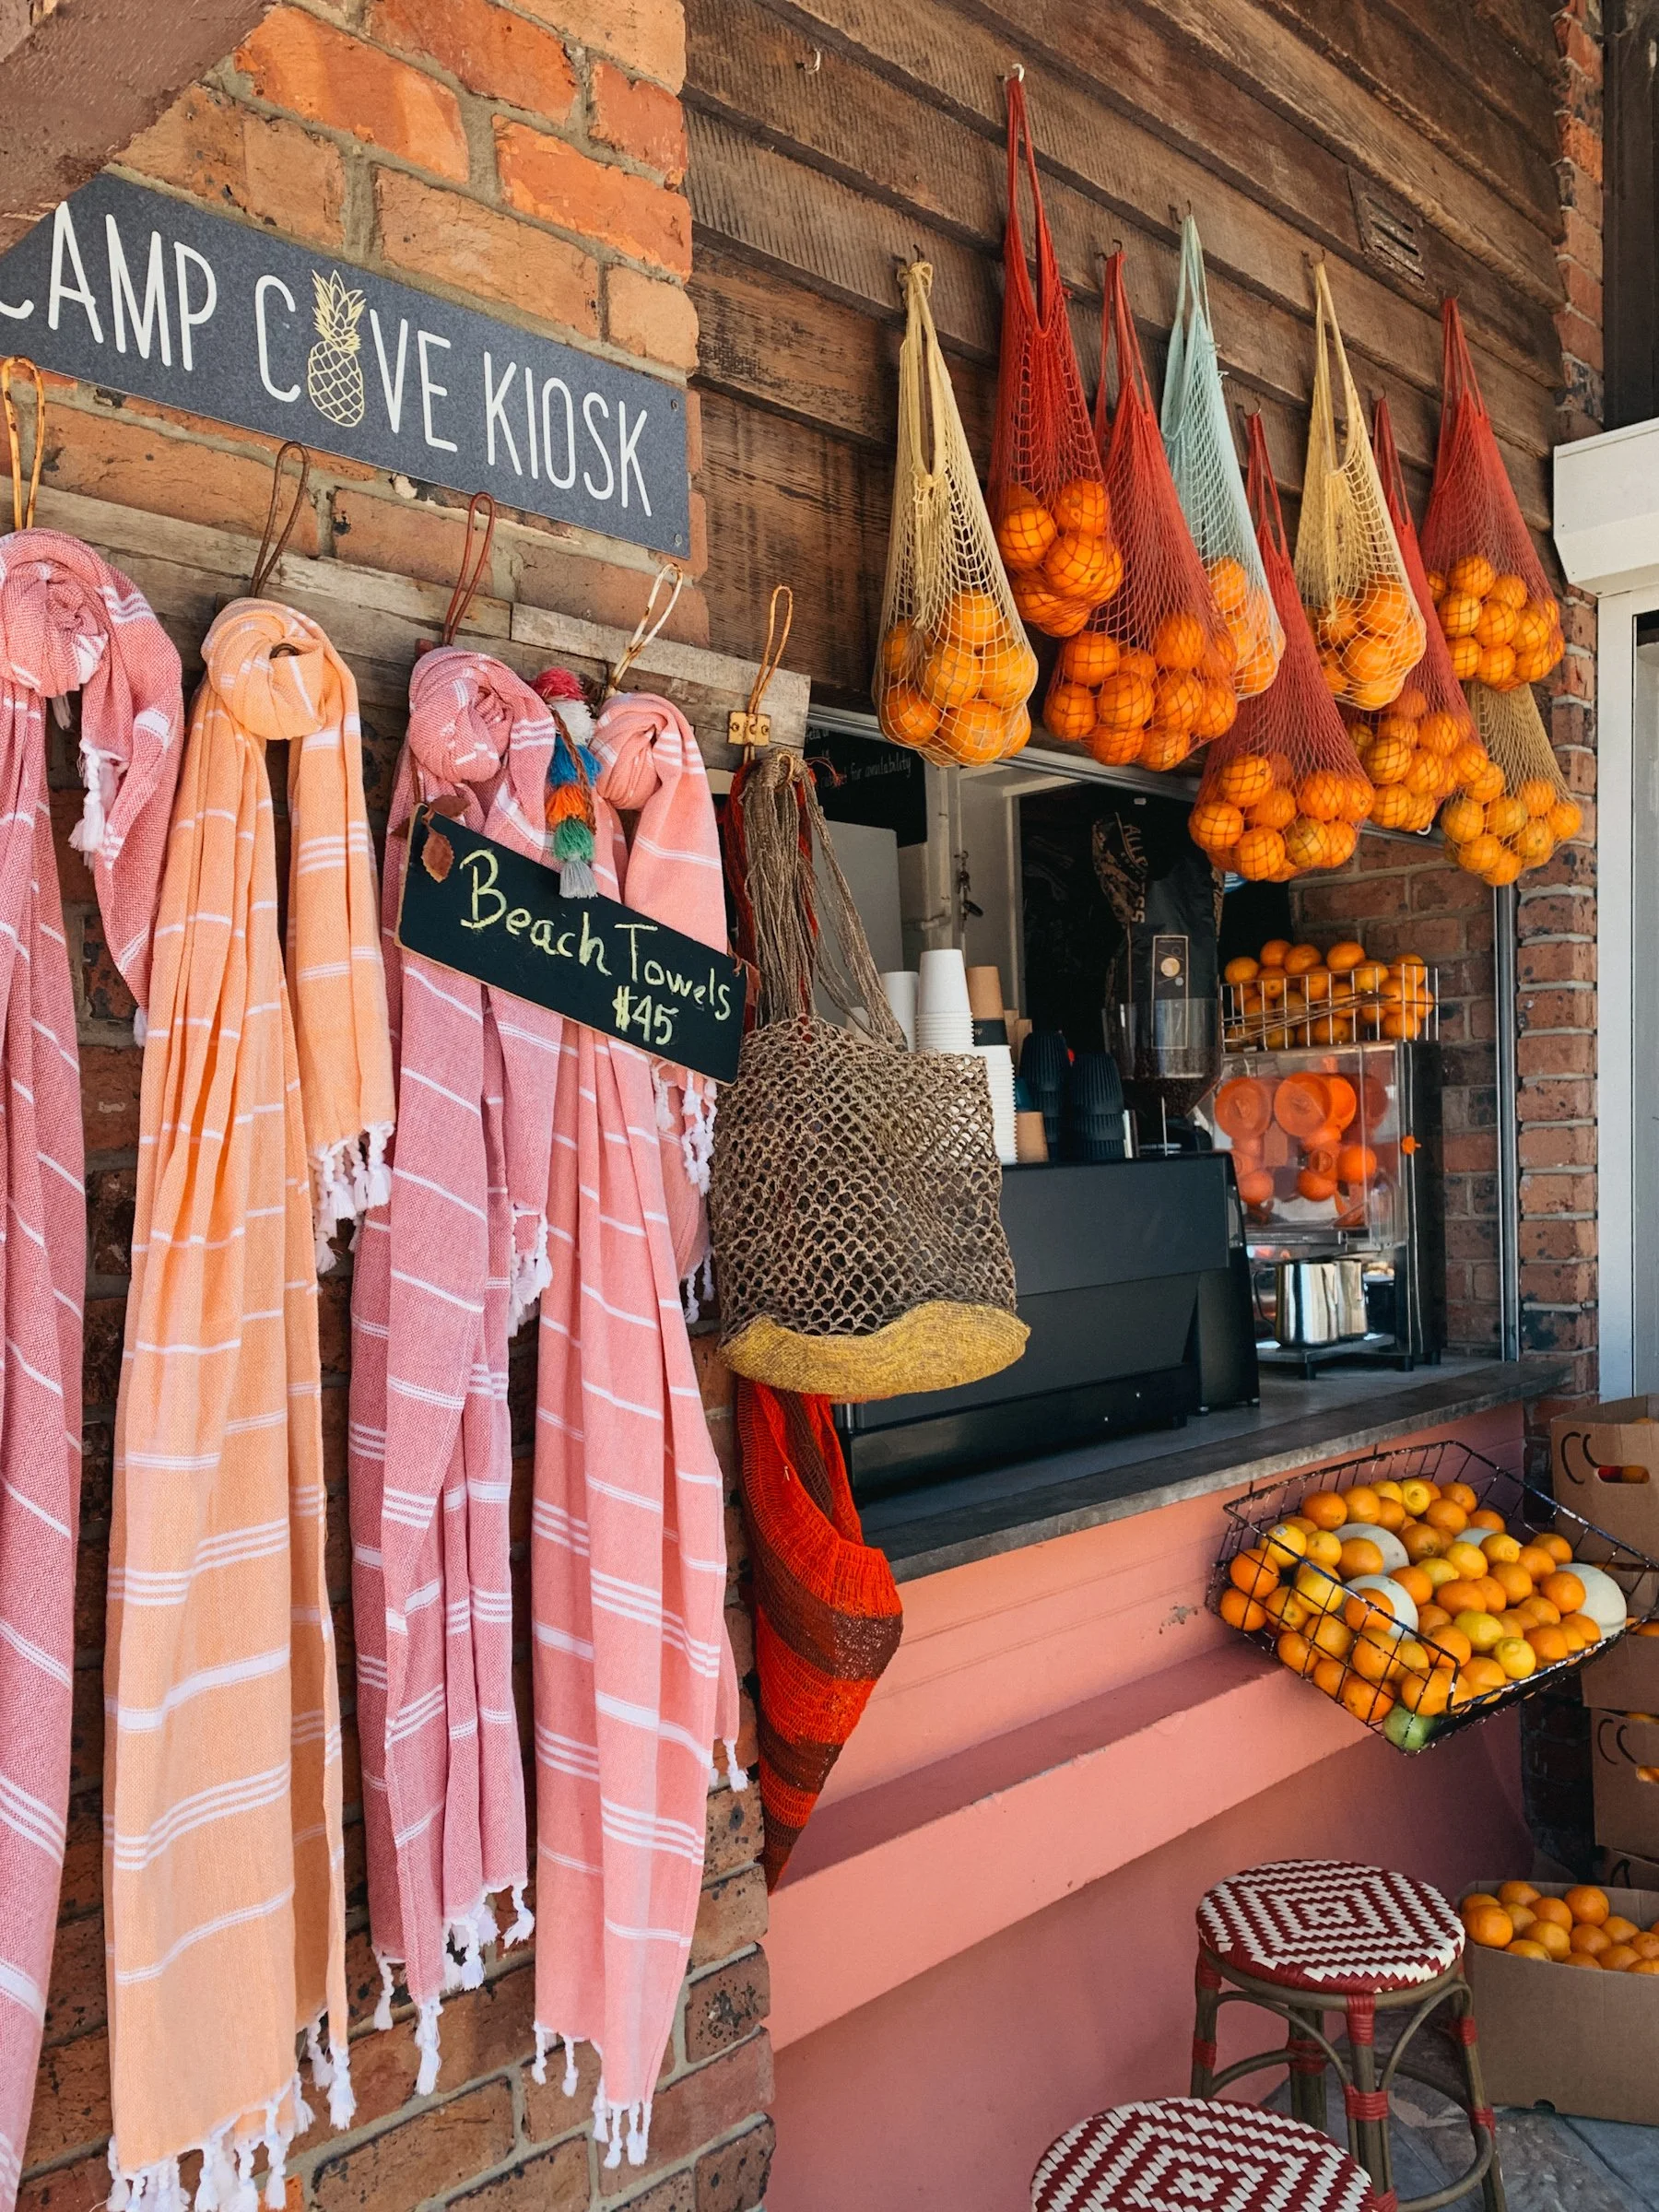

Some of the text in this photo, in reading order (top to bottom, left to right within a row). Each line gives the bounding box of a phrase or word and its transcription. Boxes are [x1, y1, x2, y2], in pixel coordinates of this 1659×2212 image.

[0, 200, 218, 371] AMP
[484, 351, 653, 517] KIOSK
[459, 848, 732, 1021] Beach Towels
[1122, 823, 1148, 924] ALLPSS
[611, 985, 679, 1046] $45
